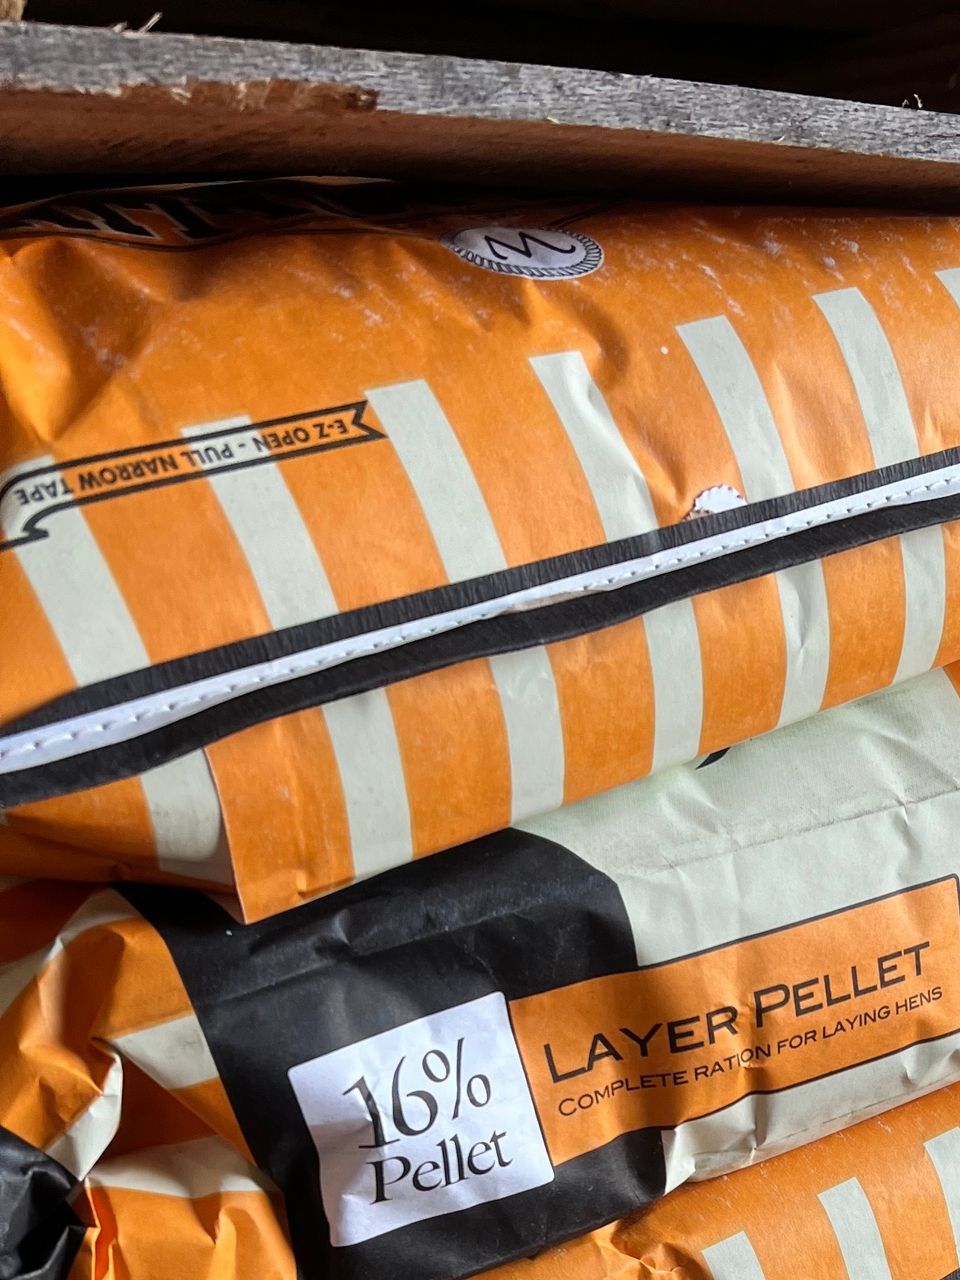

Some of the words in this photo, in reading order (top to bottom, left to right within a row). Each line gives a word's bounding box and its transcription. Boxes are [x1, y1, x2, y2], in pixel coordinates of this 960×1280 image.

[253, 429, 310, 454] OPEN
[318, 419, 348, 439] E-Z
[78, 455, 179, 492] NARROW
[189, 442, 235, 468] PULL
[19, 475, 74, 505] TAPE
[542, 1005, 738, 1084] LAYER
[754, 941, 932, 1029] PELLET
[558, 1068, 690, 1117] COMPLETE
[694, 1045, 771, 1082] RATION
[776, 1031, 816, 1056] FOR
[821, 1006, 891, 1041] LAYING
[895, 987, 945, 1016] HENS
[343, 1036, 492, 1151] 16%
[367, 1126, 514, 1206] Pellet
